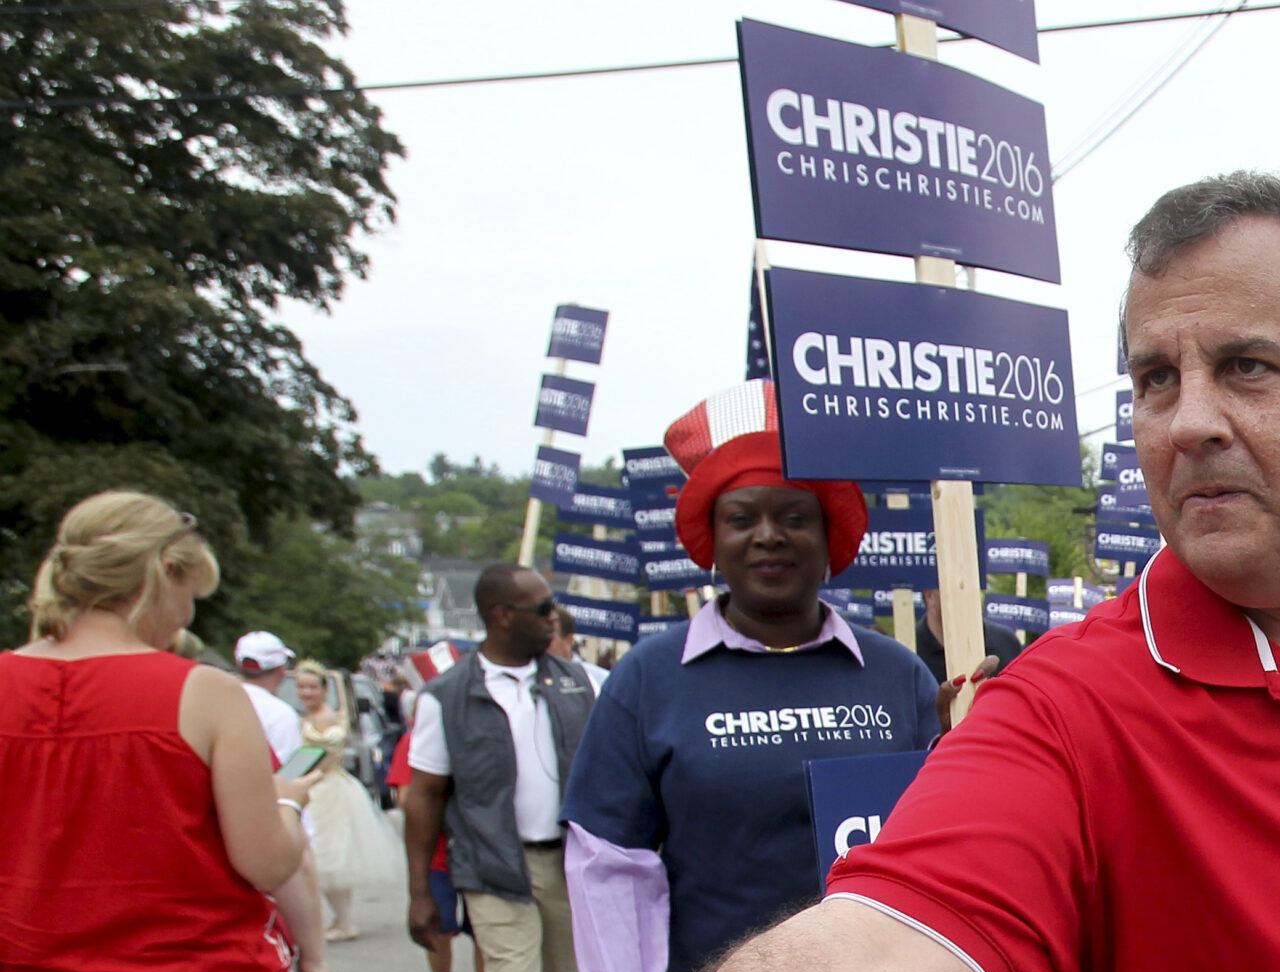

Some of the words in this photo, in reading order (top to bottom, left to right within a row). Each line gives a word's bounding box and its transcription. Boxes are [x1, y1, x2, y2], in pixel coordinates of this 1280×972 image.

[766, 88, 1044, 198] CHRISTIE2016
[776, 151, 1045, 225] CHRISCHRISTIE.COM
[792, 332, 1064, 405] CHRISTIE2016
[802, 393, 1064, 431] CHRISCHRISTIE.COM
[705, 704, 892, 736] CHRISTIE2016
[710, 734, 783, 748] TELLING
[794, 731, 808, 743] IT
[818, 730, 852, 741] LIKE
[858, 728, 872, 740] IT
[879, 729, 893, 740] IS
